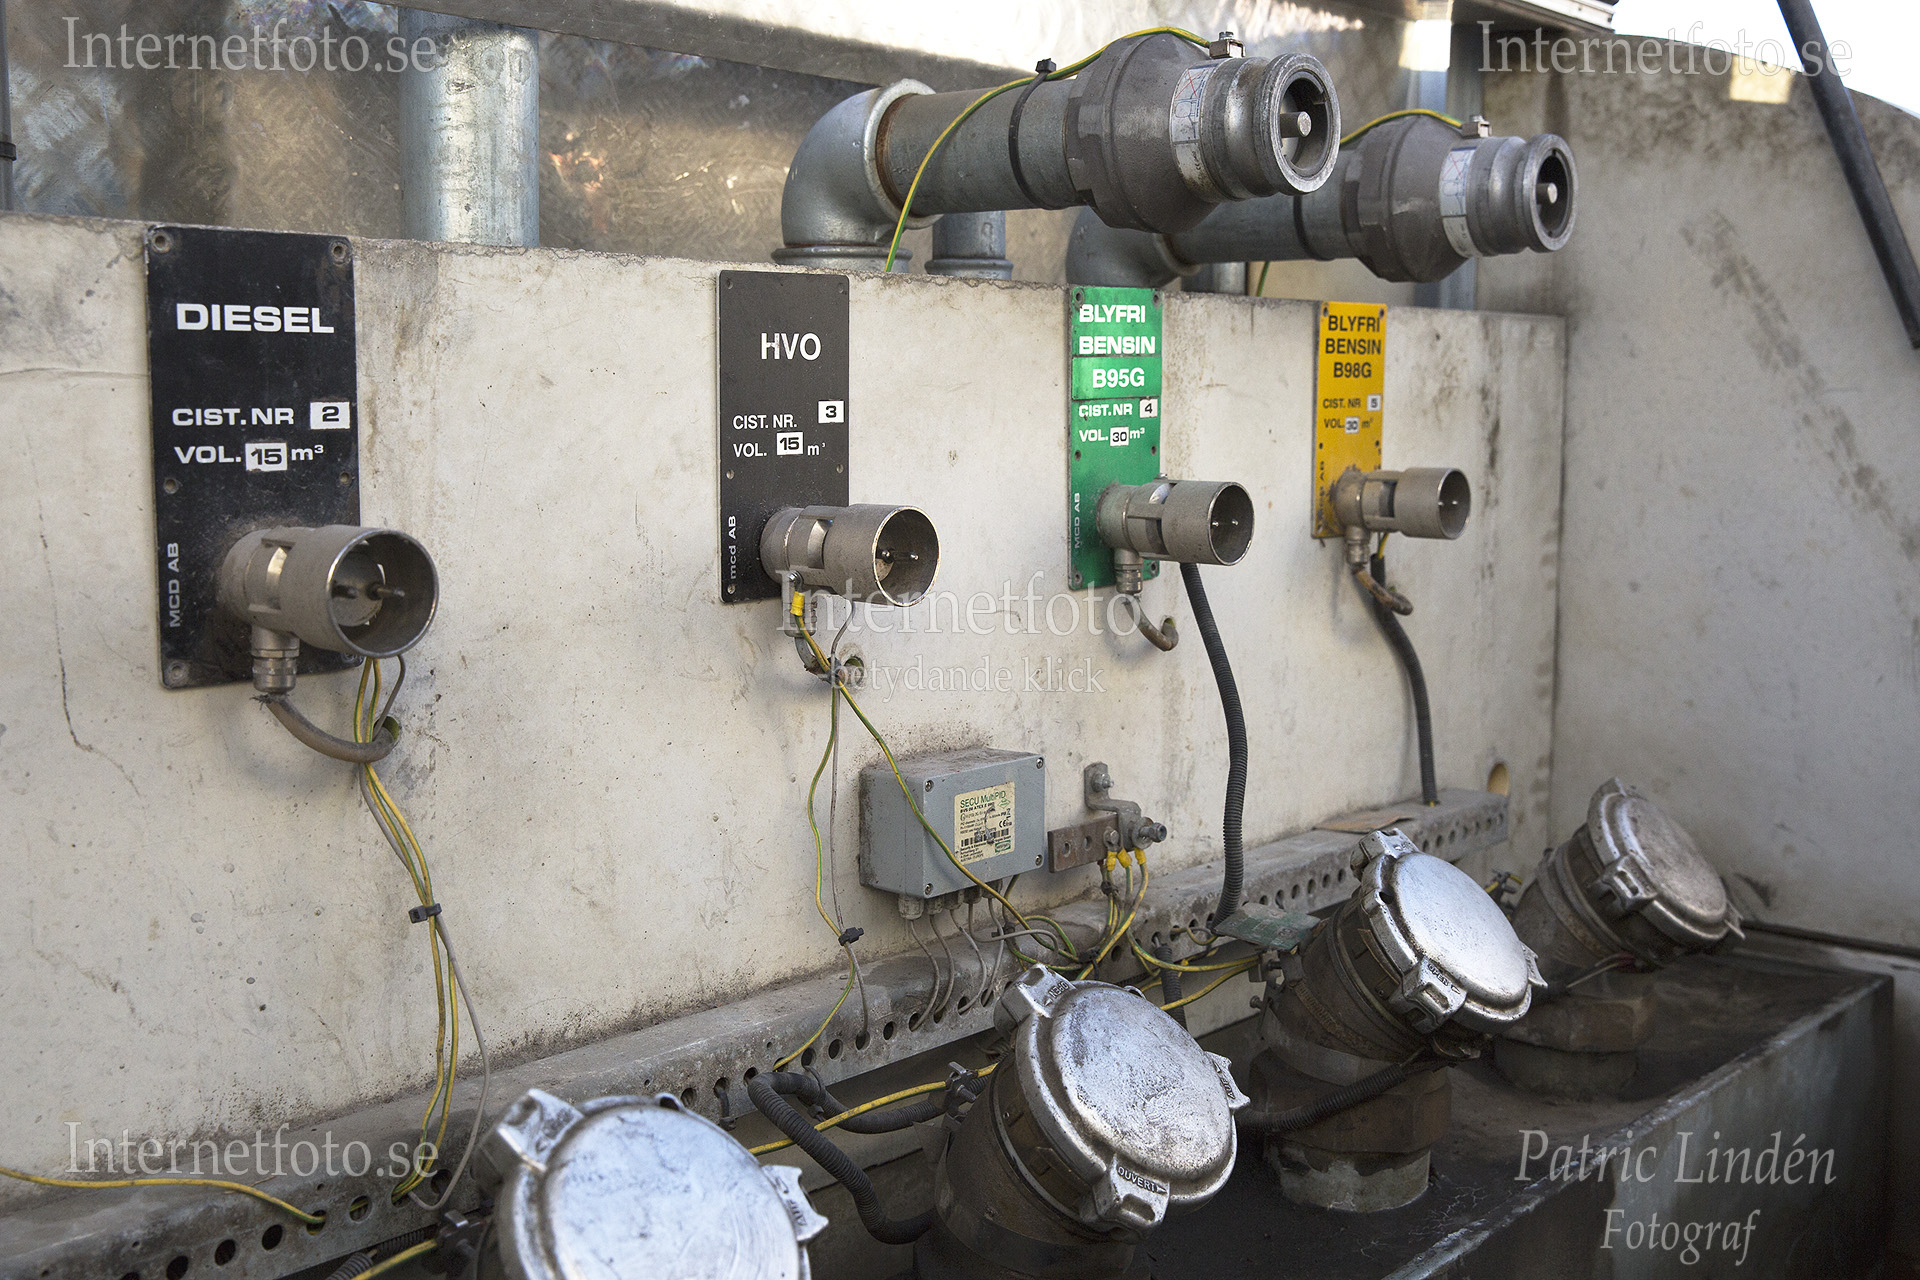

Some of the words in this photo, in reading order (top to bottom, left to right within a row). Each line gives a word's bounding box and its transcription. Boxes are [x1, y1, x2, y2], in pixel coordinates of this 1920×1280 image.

[176, 303, 335, 333] DIESEL
[1079, 304, 1146, 323] BLYFRI
[1328, 315, 1380, 332] BLYFRI
[761, 333, 822, 361] HVO
[1079, 336, 1156, 355] BENSIN
[1325, 338, 1382, 355] BENSIN
[1092, 368, 1145, 388] B95G
[1333, 362, 1372, 378] B98G
[321, 405, 341, 423] 2
[733, 415, 769, 430] CIST.
[773, 414, 797, 428] NR.
[825, 405, 837, 418] 3
[1144, 403, 1154, 414] 4
[1079, 428, 1109, 442] VOL.
[1112, 431, 1128, 443] 30
[174, 445, 242, 464] VOL.
[250, 447, 284, 467] 15
[733, 443, 767, 457] VOL.
[779, 437, 800, 450] 15
[1074, 493, 1081, 513] AB
[728, 516, 737, 540] AB
[168, 542, 179, 571] AB
[170, 573, 181, 628] MCD
[960, 797, 980, 808] SECU
[1117, 1166, 1156, 1192] OUVERT
